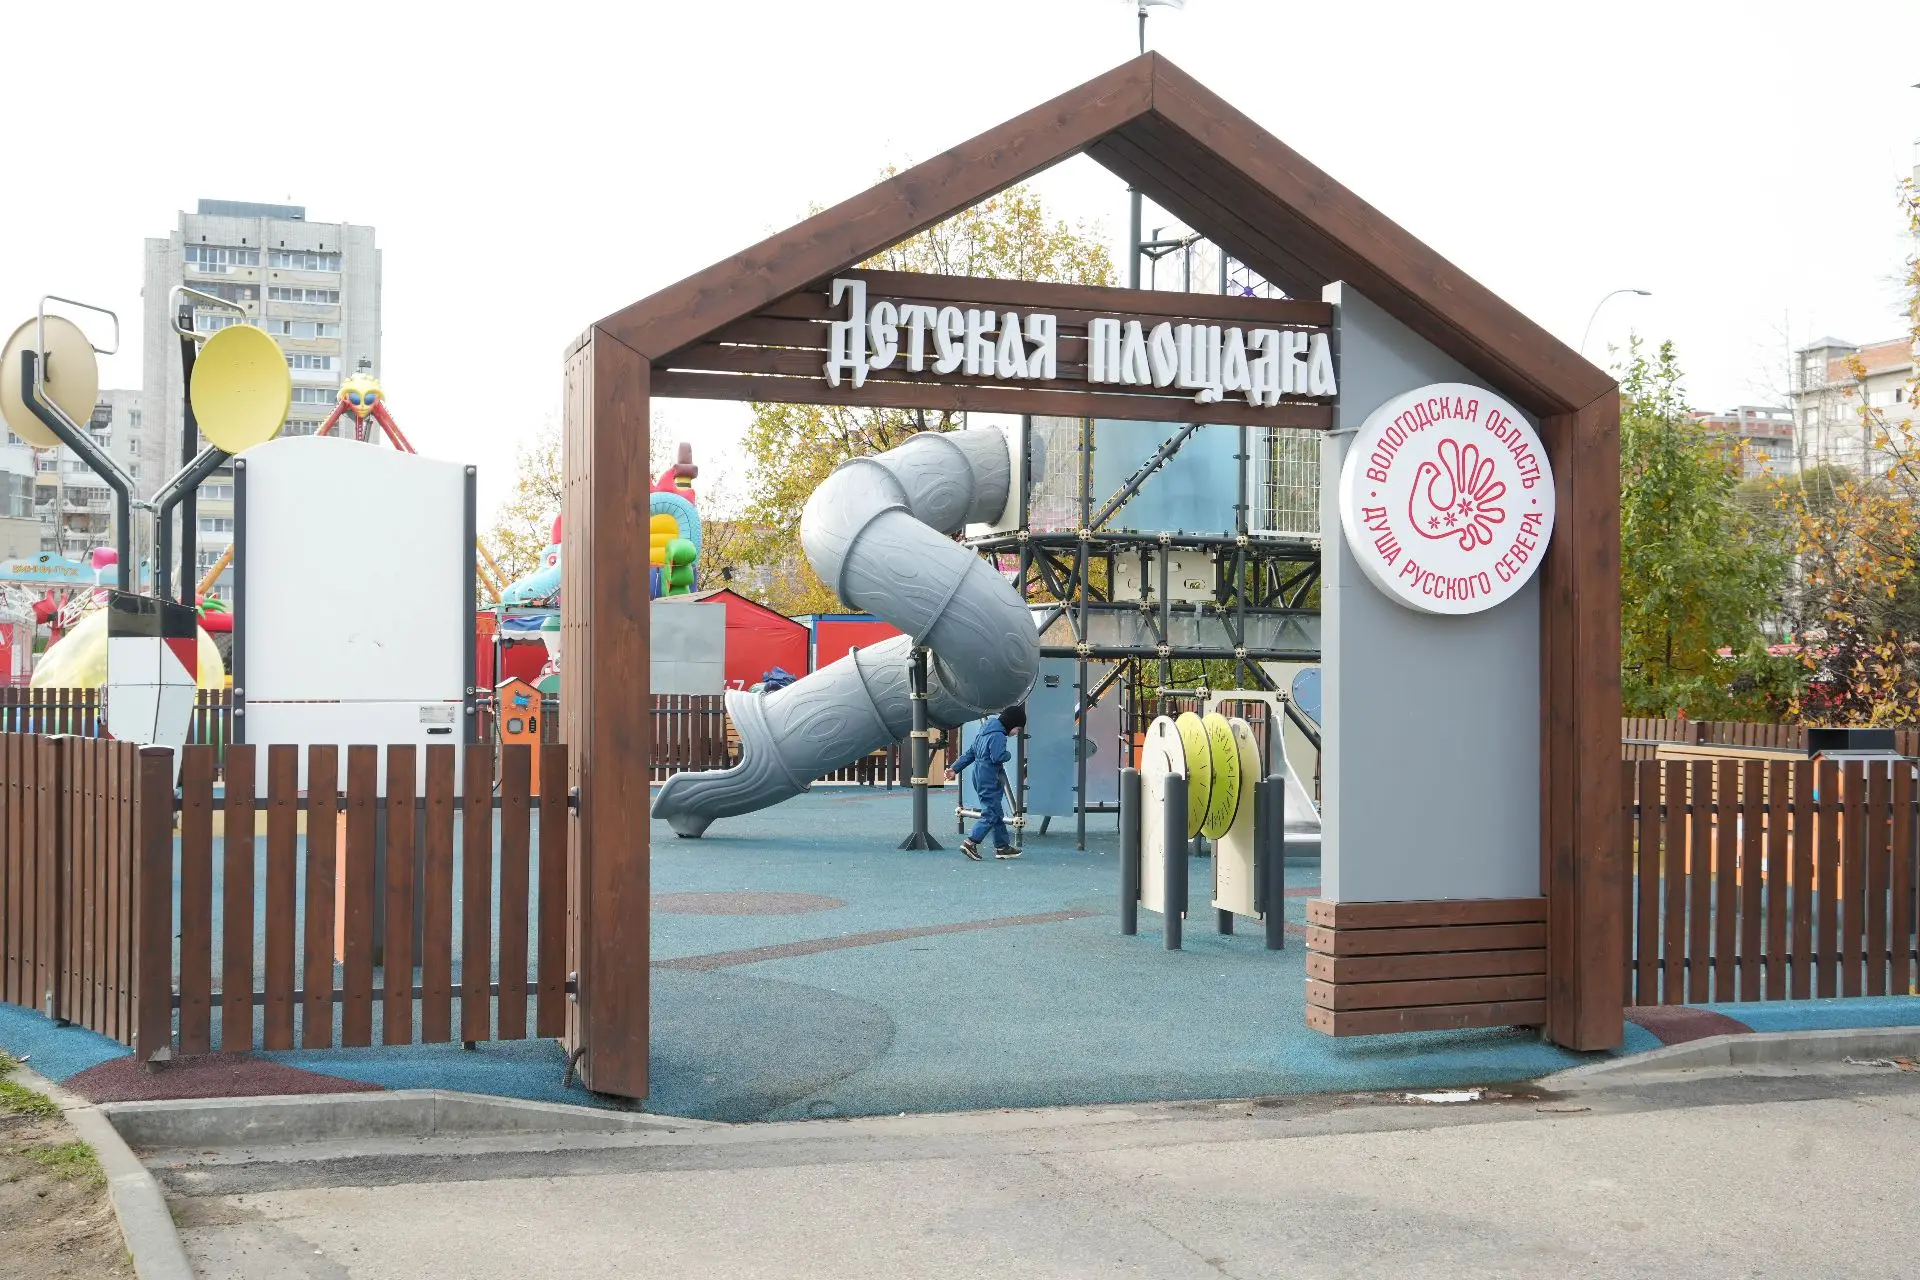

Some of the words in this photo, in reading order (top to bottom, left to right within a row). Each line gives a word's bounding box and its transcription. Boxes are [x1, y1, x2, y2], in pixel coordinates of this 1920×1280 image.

[1366, 396, 1479, 483] ВОЛОГОДСКАЯ
[1485, 409, 1541, 489] ОБЛАСТЬ
[1361, 506, 1403, 567] ДУША
[1398, 558, 1492, 601] РУССКОГО
[1494, 511, 1543, 583] СЕВЕРА
